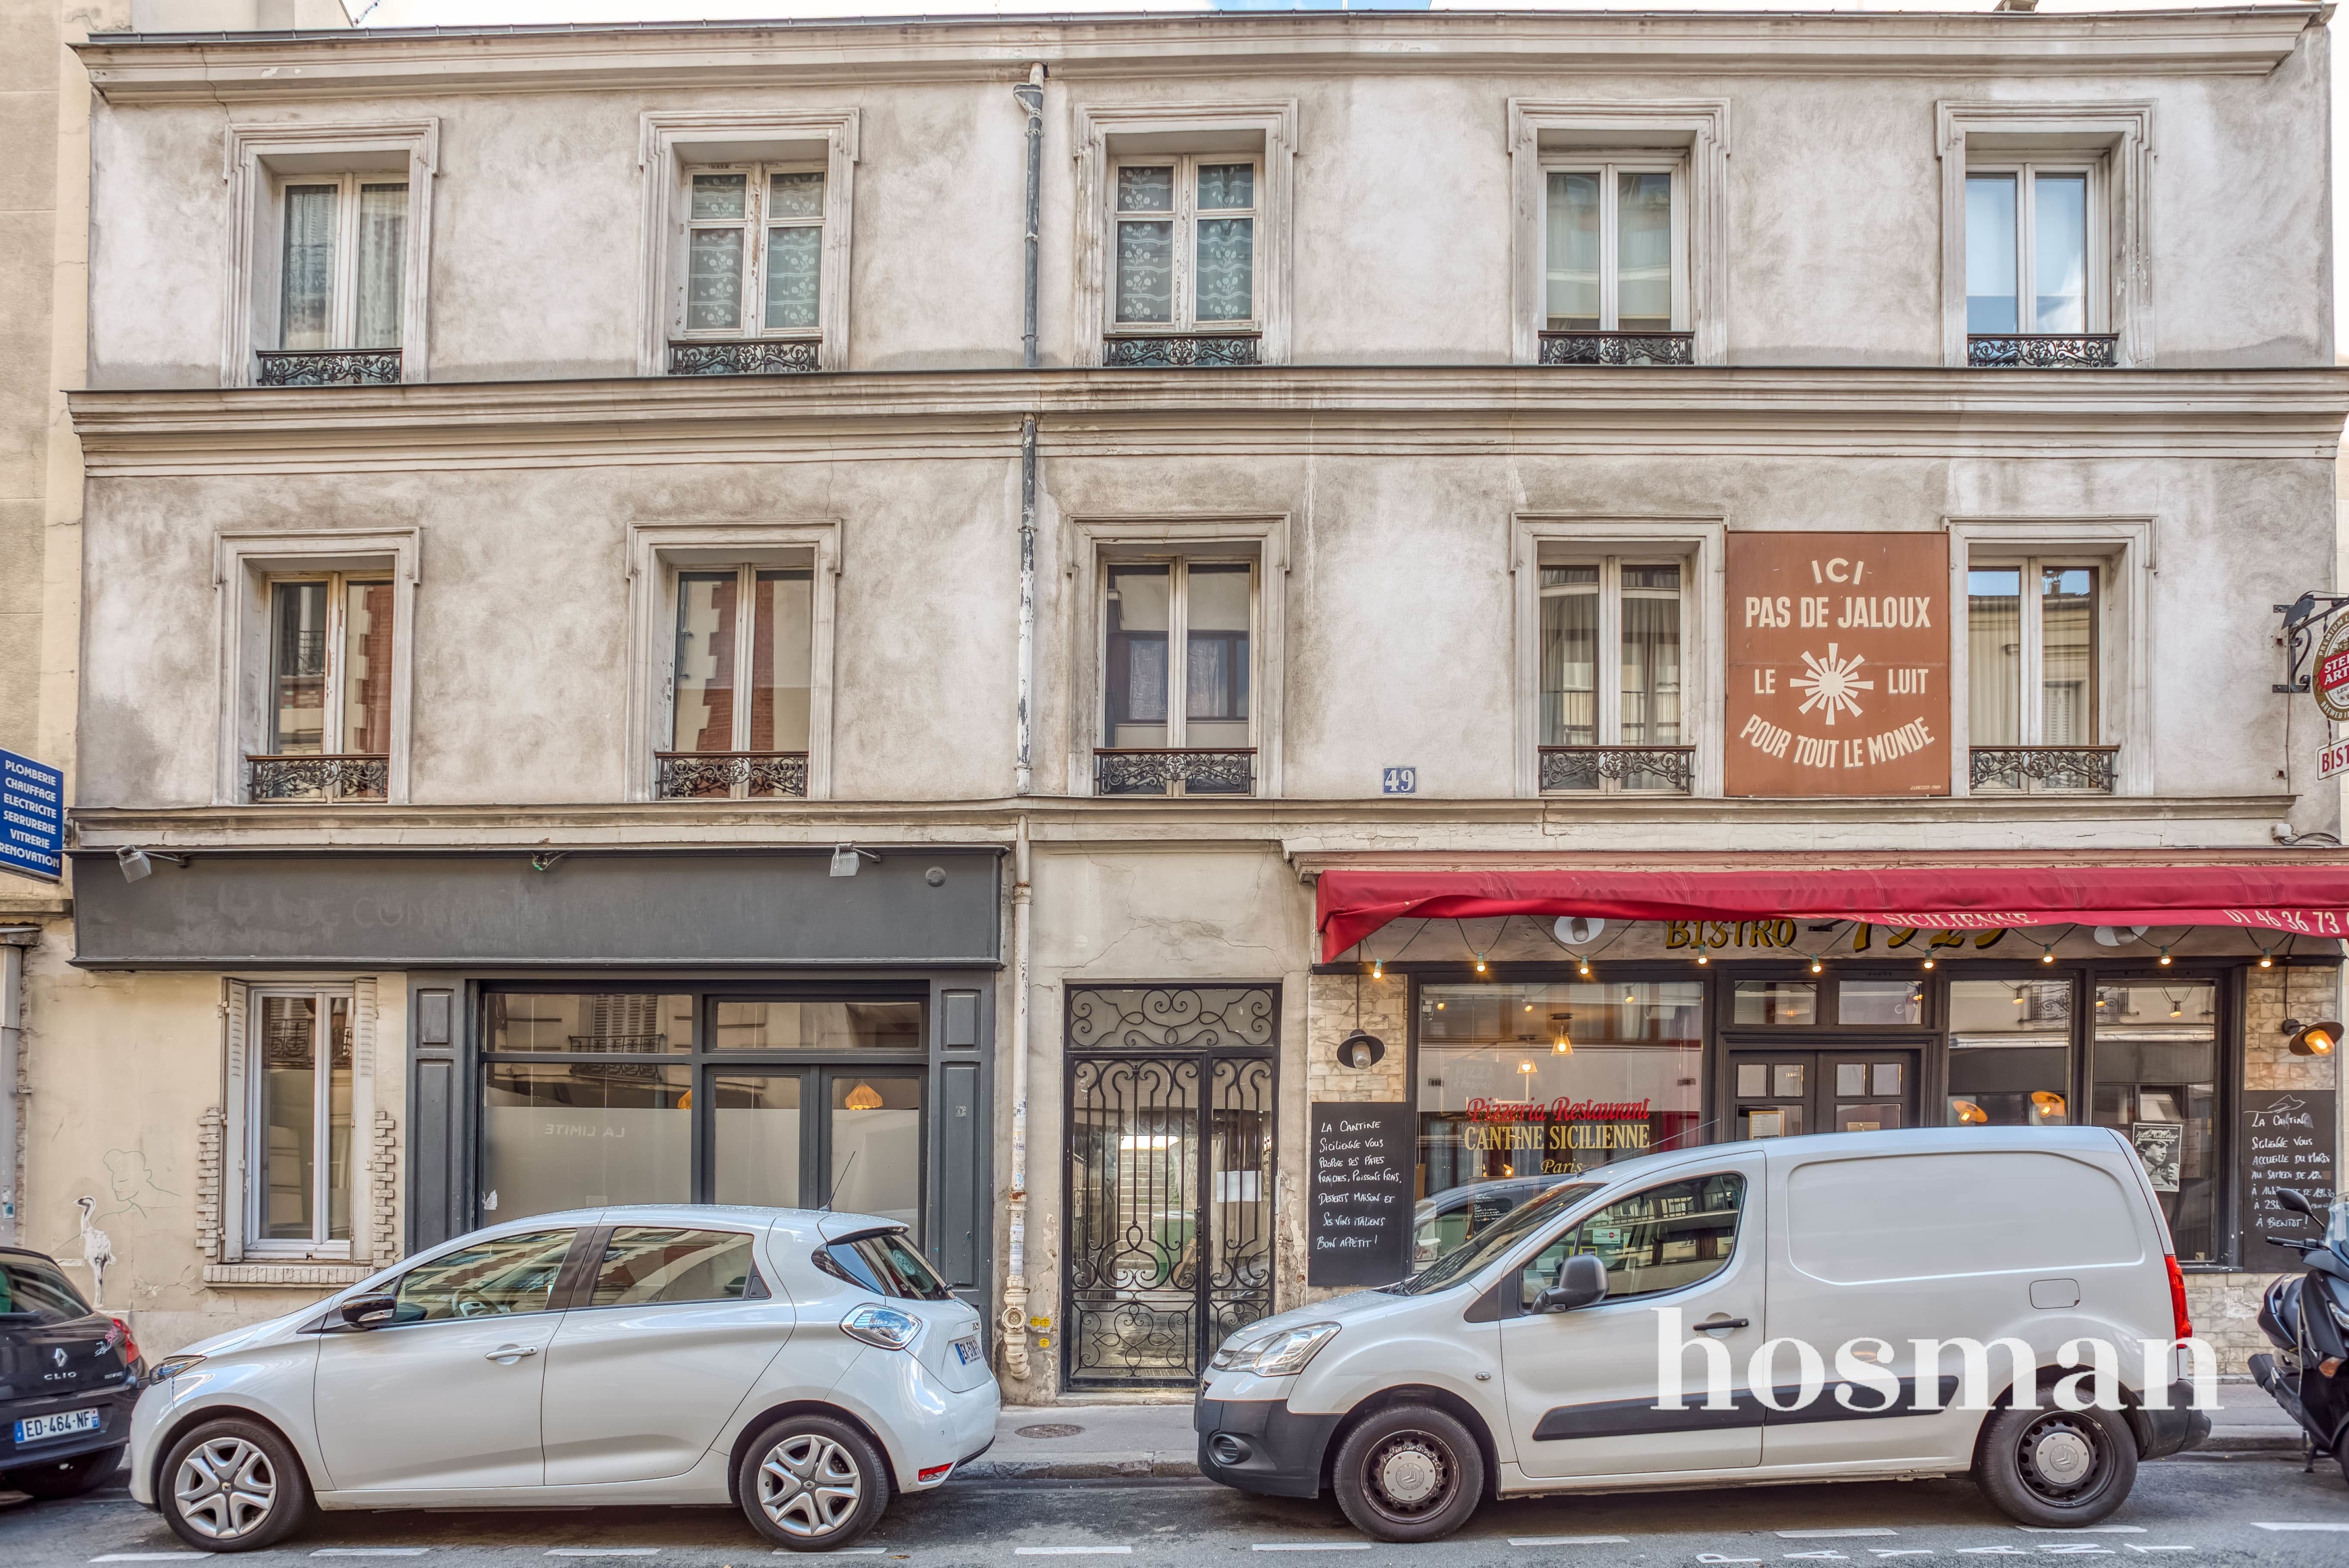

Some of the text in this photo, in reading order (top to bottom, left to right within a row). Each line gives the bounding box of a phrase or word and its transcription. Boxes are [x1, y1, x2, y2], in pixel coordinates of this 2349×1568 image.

[1812, 558, 1864, 585] ICI
[1746, 597, 1931, 628] PAS DE JALOUX
[2318, 618, 2343, 656] PREMIUM
[1754, 669, 1929, 694] LE LUIT
[2321, 701, 2342, 719] BREWED
[1740, 714, 1935, 769] POUR TOUT LE MONDE
[5, 759, 56, 786] PLOMBERIE
[1385, 770, 1414, 791] 49
[5, 777, 56, 803] CHAUFFAGE
[3, 793, 57, 819] ELECTRICITE
[3, 810, 56, 835] SERRURERIE
[10, 828, 50, 849] VITRERIE
[0, 842, 59, 868] RENOVATION
[1882, 913, 2039, 927] SICILIENNE
[2223, 910, 2252, 923] 01
[2255, 910, 2281, 927] 46
[2281, 911, 2310, 932] 36
[2313, 911, 2340, 934] 73
[1665, 920, 1797, 949] BISTRO
[1467, 1097, 1651, 1122] Pizzeria Restaurant
[1465, 1124, 1650, 1150] CANTINE SICILIENNE
[1540, 1159, 1583, 1174] Paris
[44, 1371, 77, 1380] CLIO
[26, 1411, 90, 1437] ED-464-NF
